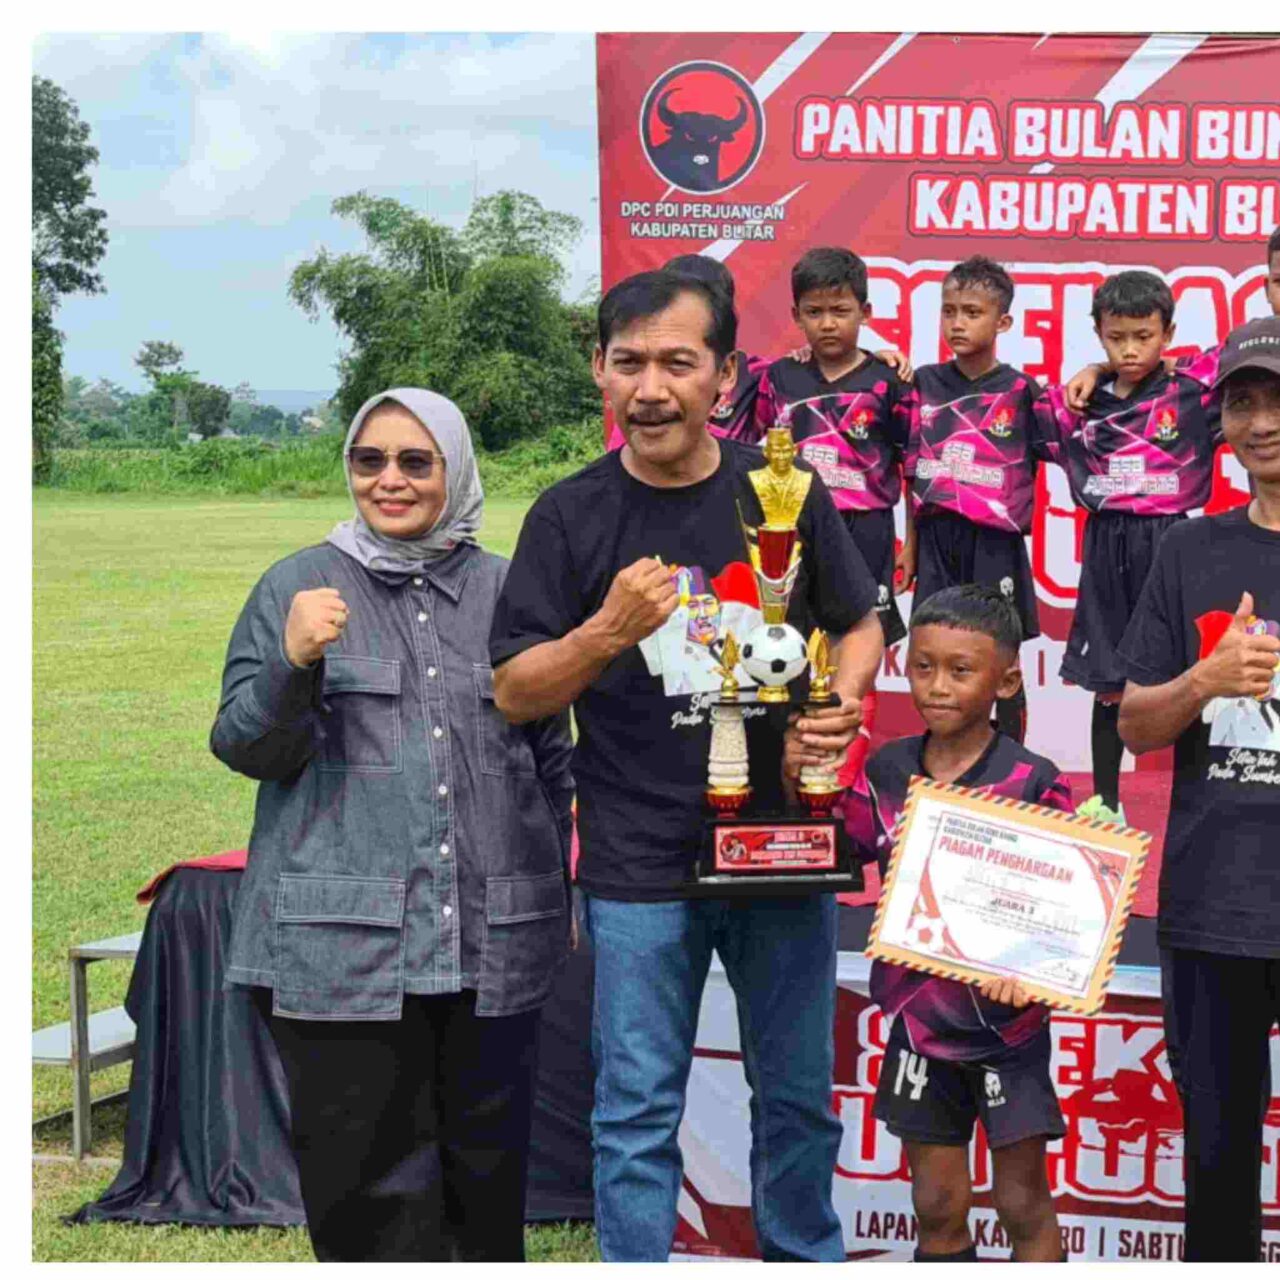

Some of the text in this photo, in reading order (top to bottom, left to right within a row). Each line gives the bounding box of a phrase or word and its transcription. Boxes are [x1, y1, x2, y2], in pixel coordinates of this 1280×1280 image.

[800, 103, 998, 157] PANITIA
[1014, 106, 1181, 160] BULAN
[621, 203, 785, 222] DPC PDI PERJUANGAN
[631, 223, 775, 240] KABUPATEN BLITAR
[915, 179, 1208, 235] KABUPATEN
[938, 835, 1074, 883] PIAGAM PENGHARGAAN
[894, 1049, 929, 1101] 14
